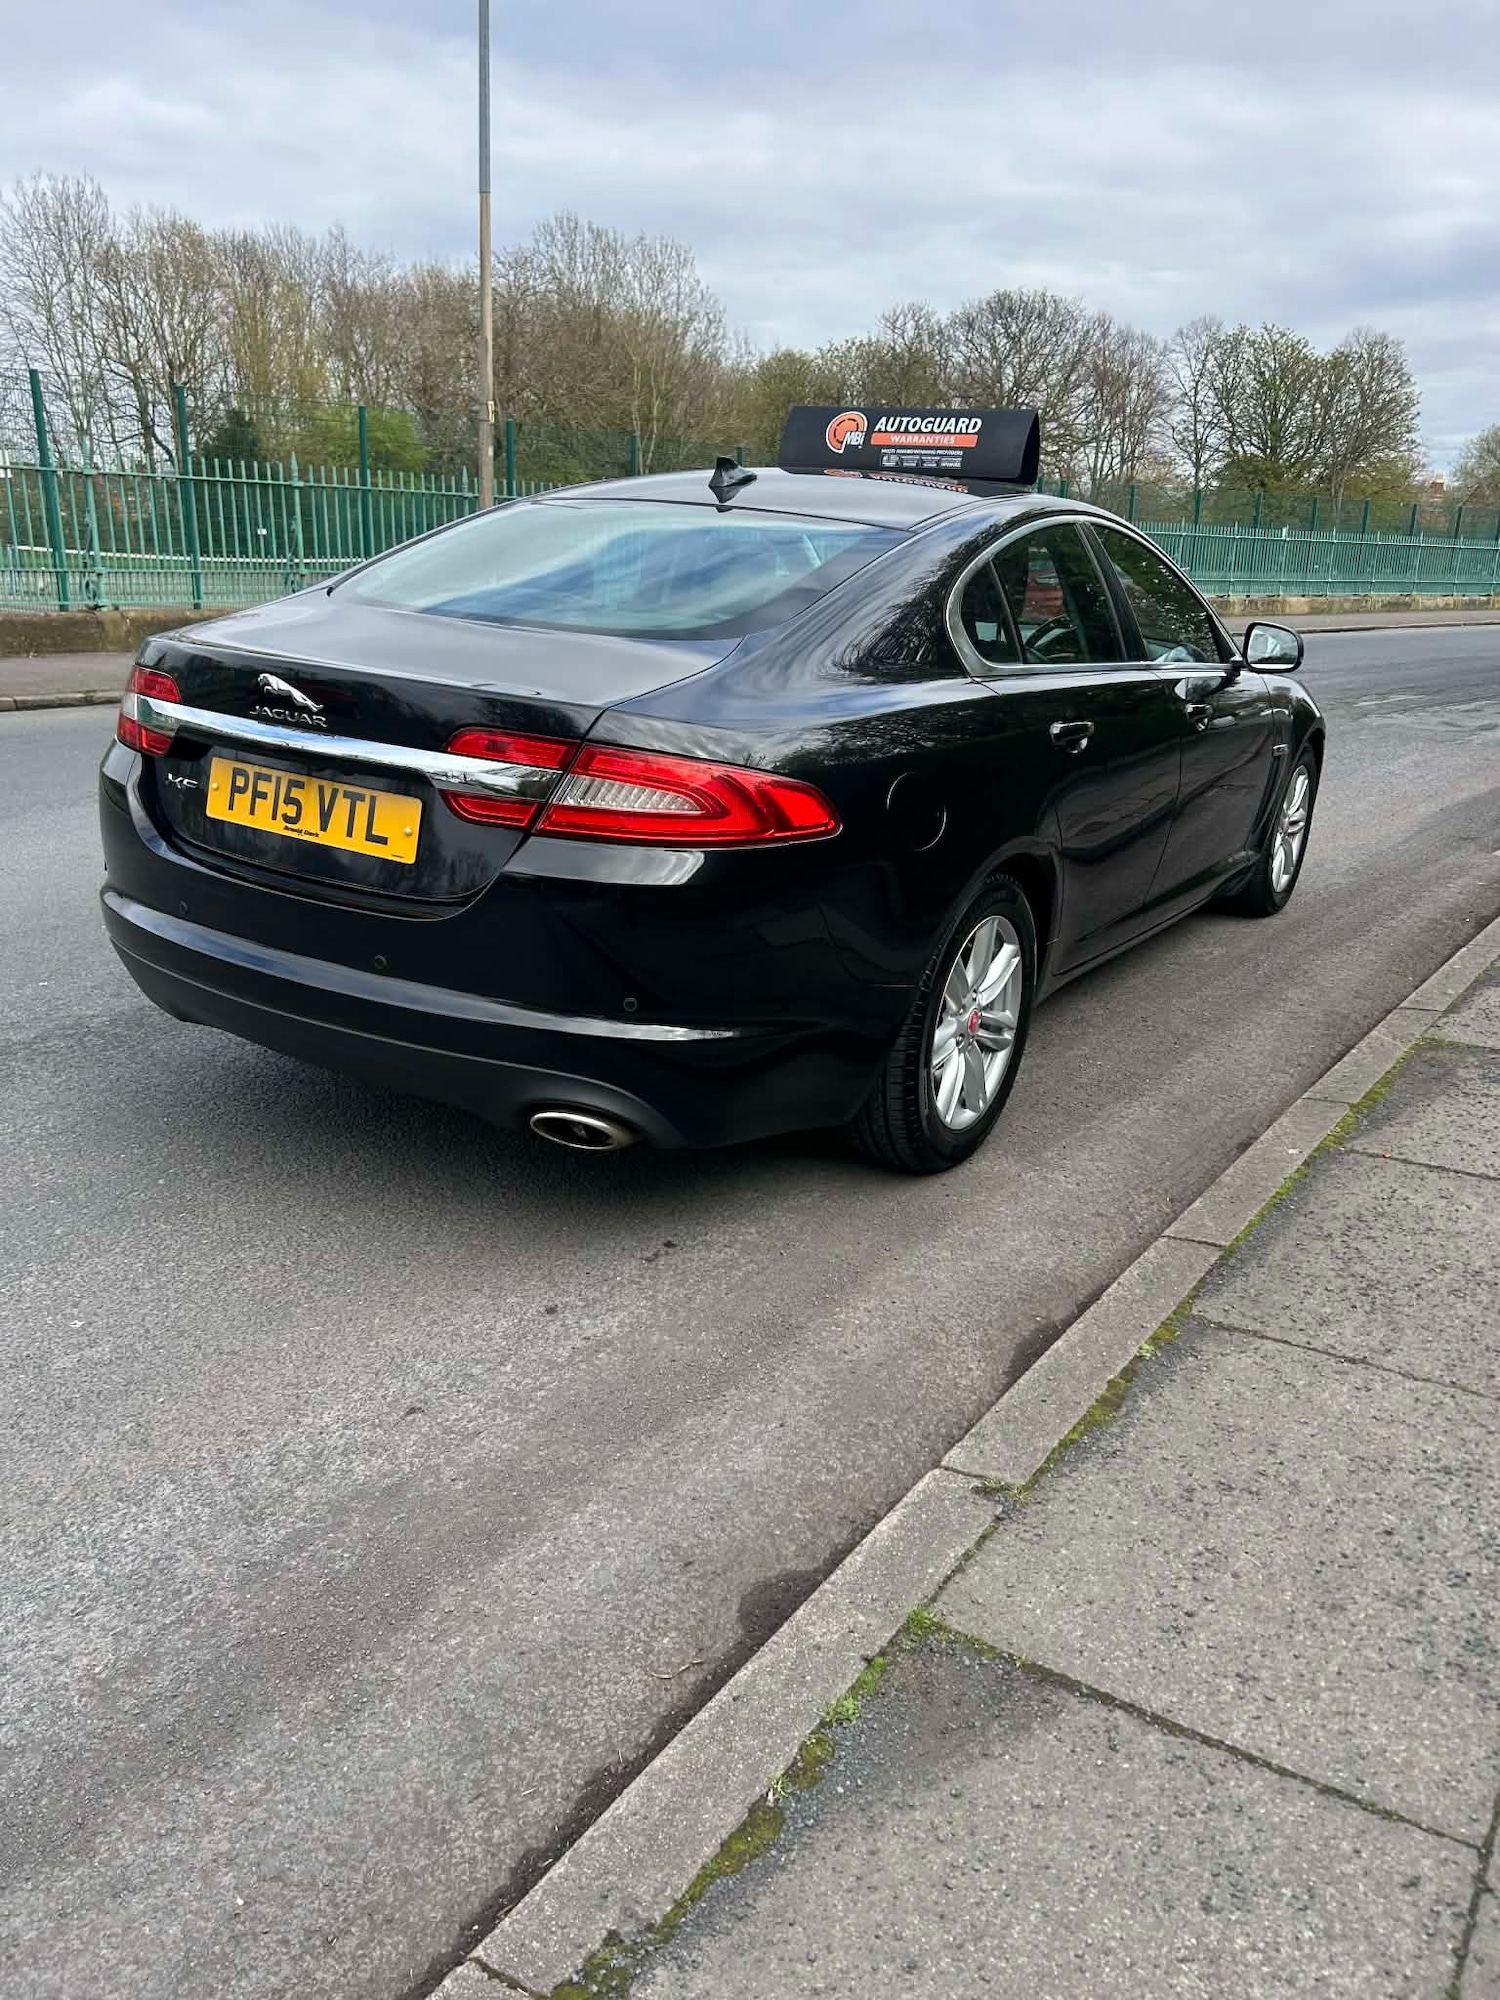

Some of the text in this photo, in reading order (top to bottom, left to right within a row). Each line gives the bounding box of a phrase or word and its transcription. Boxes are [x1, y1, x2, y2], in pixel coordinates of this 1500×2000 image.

[874, 417, 982, 433] AUTOGUARD
[890, 434, 955, 444] WARRANTIES
[250, 705, 328, 727] JAGUAR
[228, 766, 389, 846] PF15 VTL
